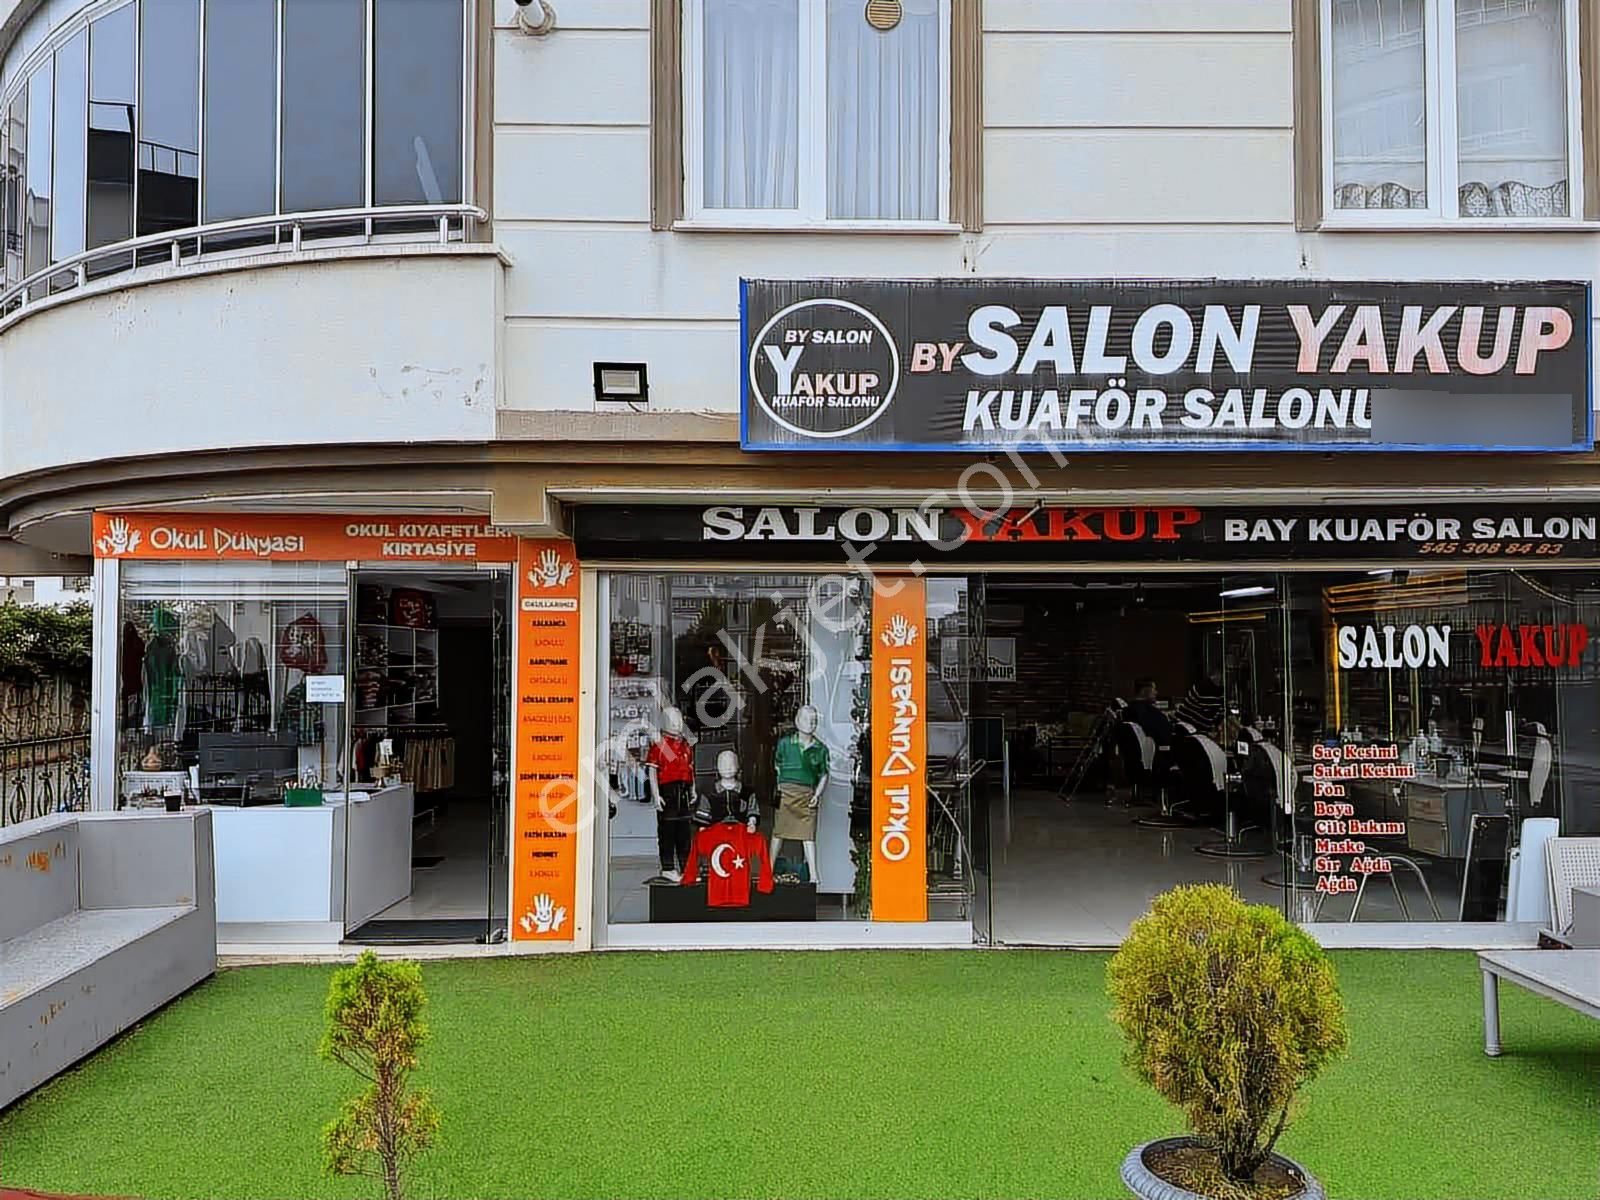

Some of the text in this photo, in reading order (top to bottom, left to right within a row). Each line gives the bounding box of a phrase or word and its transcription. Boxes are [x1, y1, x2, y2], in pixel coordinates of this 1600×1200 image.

[784, 330, 872, 344] BY SALON
[910, 304, 1573, 376] BY SALON YAKUP
[763, 345, 879, 395] YAKUP
[828, 396, 880, 407] SALONU
[962, 378, 1167, 431] KUAFÖR
[346, 524, 395, 537] OKUL
[702, 506, 1202, 542] SALON YAKUP
[1224, 513, 1597, 541] BAY KUAFÖR SALON
[150, 527, 207, 550] Okul
[382, 540, 477, 556] KIRTASİYE
[1338, 623, 1589, 668] SALON YAKUP
[1344, 744, 1398, 760] Kesimi
[1313, 763, 1416, 779] Sakal Kesimi
[1314, 801, 1354, 819] Boya
[881, 784, 911, 861] Okul
[1315, 819, 1406, 835] Cilt Bakımı
[1315, 838, 1365, 853] Maske
[1350, 856, 1392, 875] Ağda
[1316, 875, 1357, 894] Ağda
